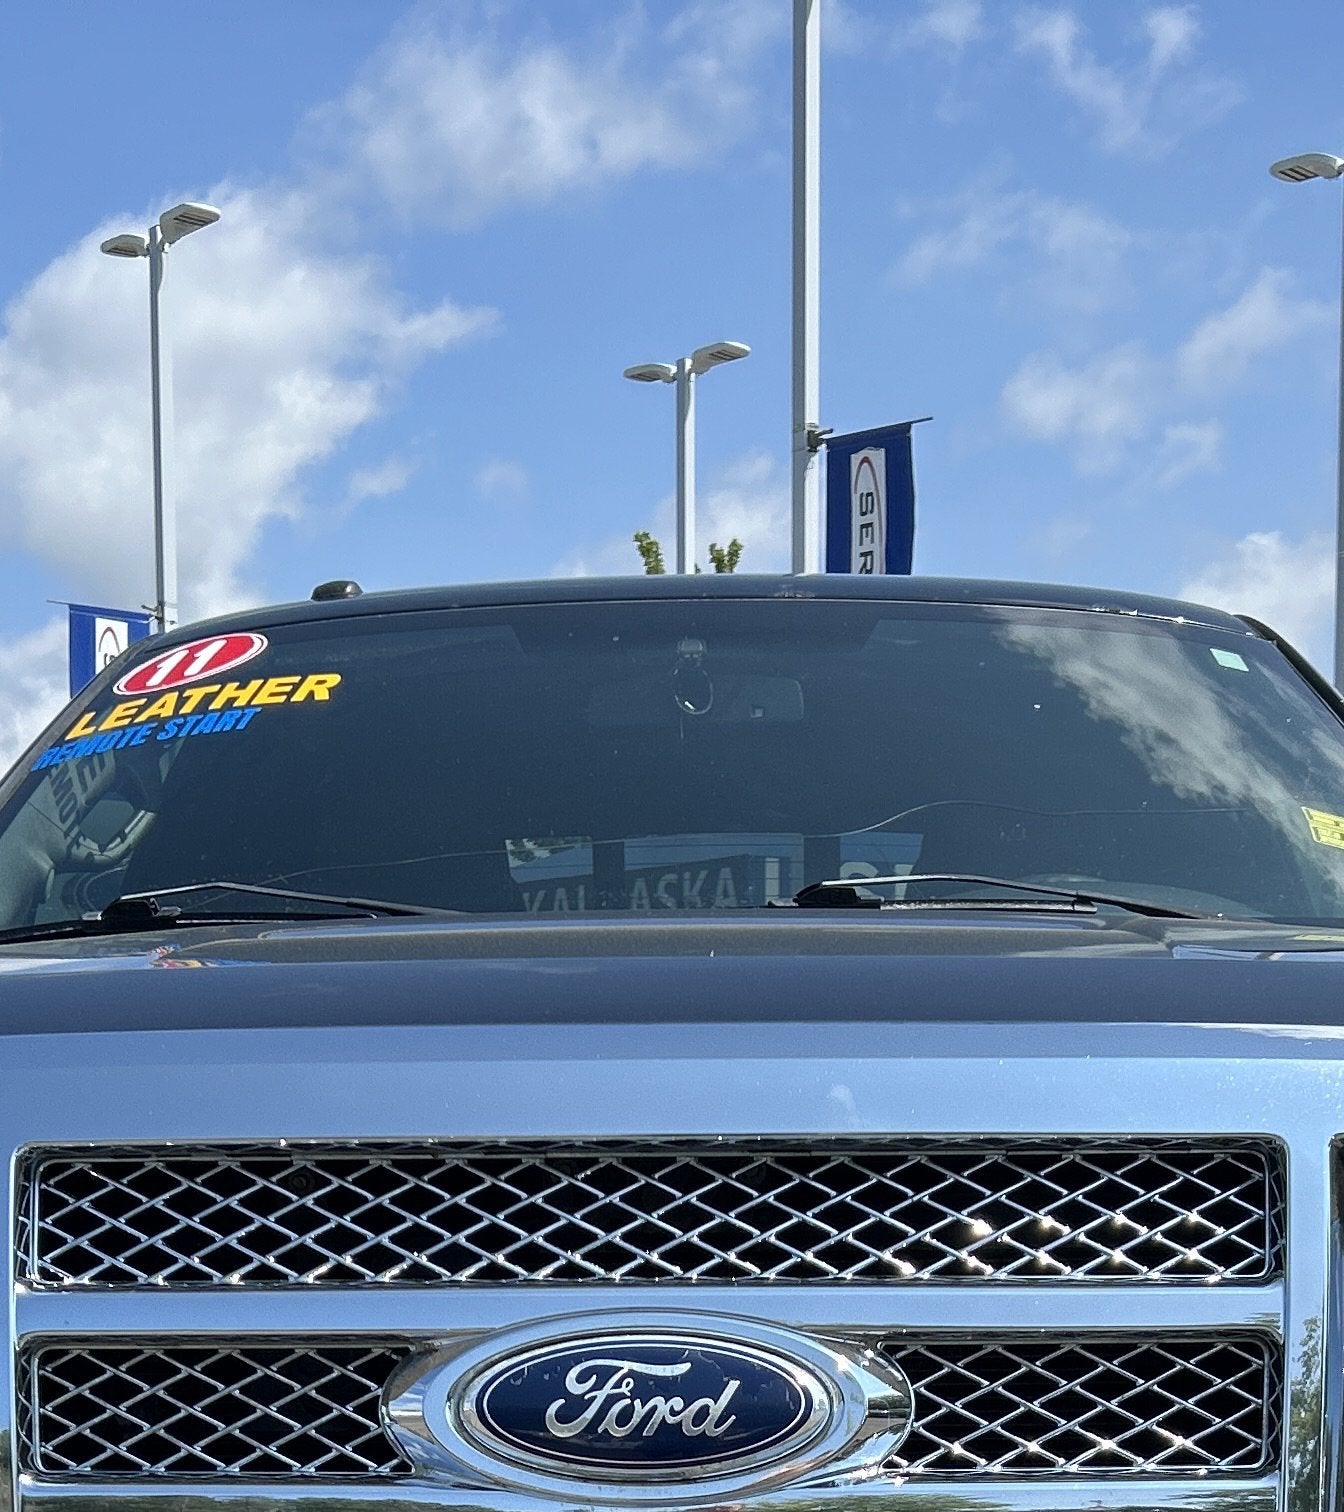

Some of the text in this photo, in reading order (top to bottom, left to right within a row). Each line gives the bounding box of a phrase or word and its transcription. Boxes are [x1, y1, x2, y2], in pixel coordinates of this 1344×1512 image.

[145, 639, 229, 687] 11
[30, 707, 263, 772] REMOTE START
[65, 673, 342, 741] LEATHER
[545, 1358, 740, 1438] Ford
